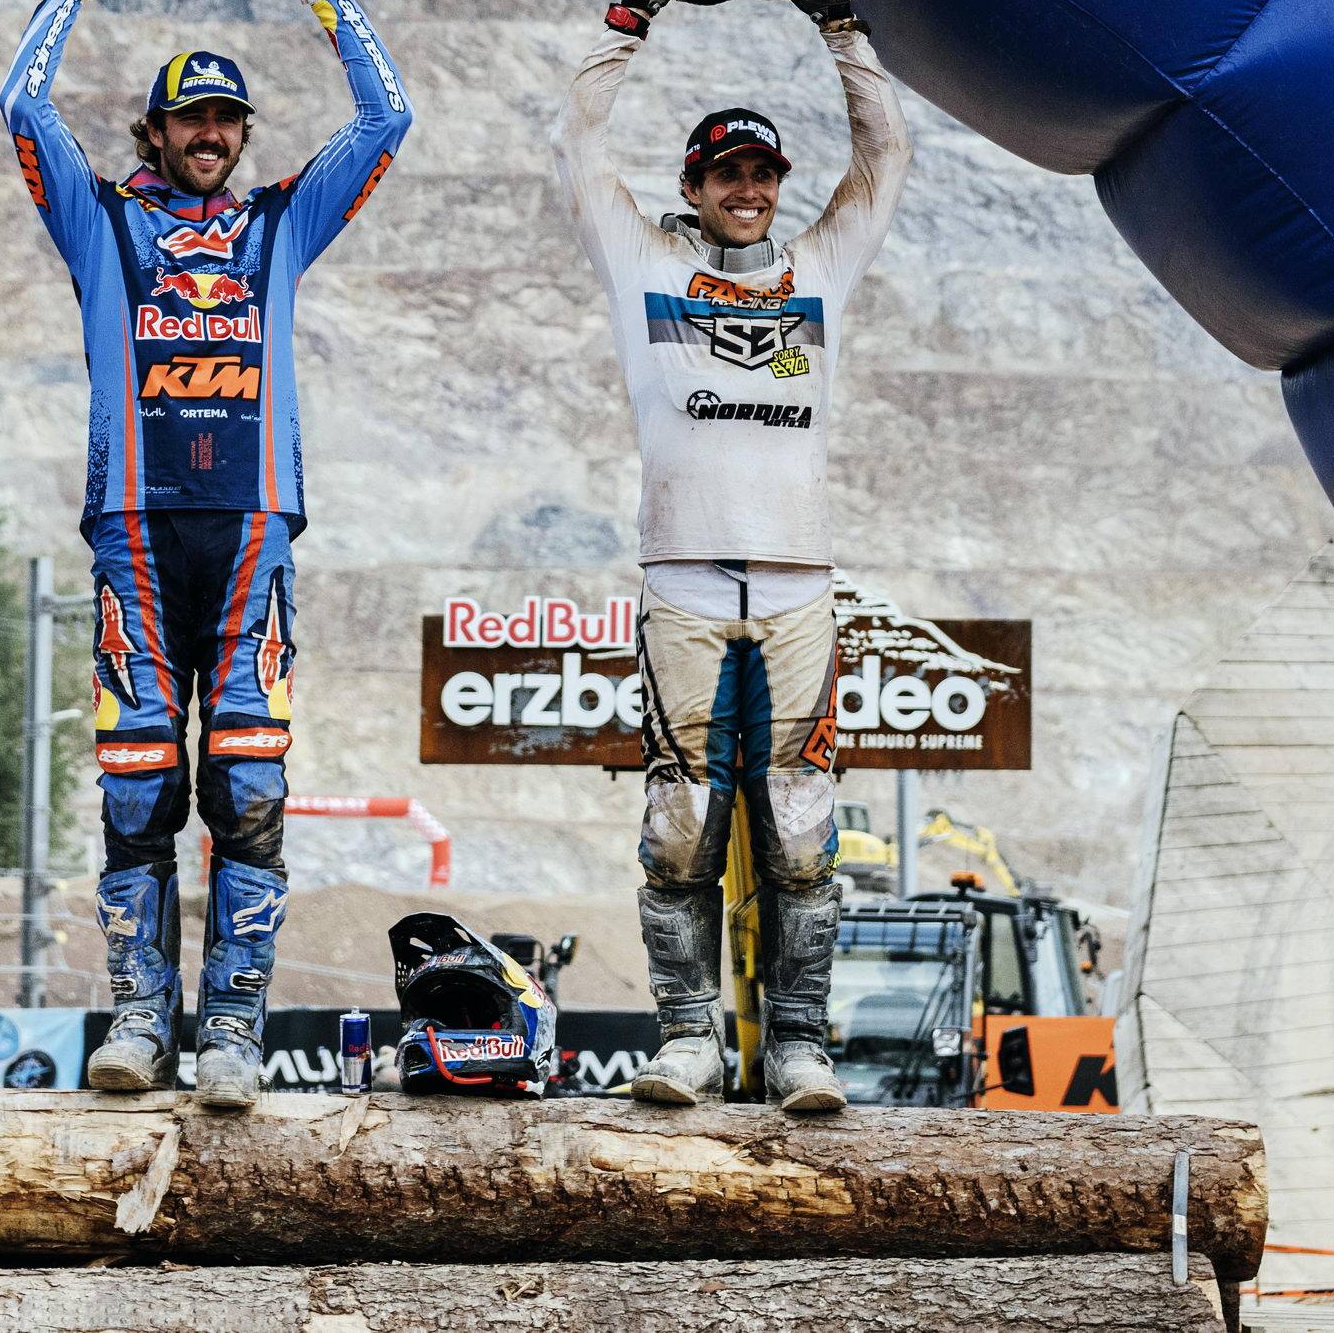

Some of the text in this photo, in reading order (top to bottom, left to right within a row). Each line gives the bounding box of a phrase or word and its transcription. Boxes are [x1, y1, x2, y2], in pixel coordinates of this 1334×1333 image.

[182, 78, 238, 92] MICHELIN
[727, 119, 777, 143] PLEWS
[136, 305, 262, 343] Red Bull
[773, 346, 800, 362] SORRY
[140, 355, 261, 399] KTM
[179, 409, 229, 419] ORTEMA
[697, 403, 812, 422] NORDICA
[447, 598, 635, 645] Red Bull
[218, 731, 290, 748] astars
[859, 734, 917, 749] ENDURO
[920, 734, 983, 749] SUPREME
[485, 1034, 524, 1059] Bull
